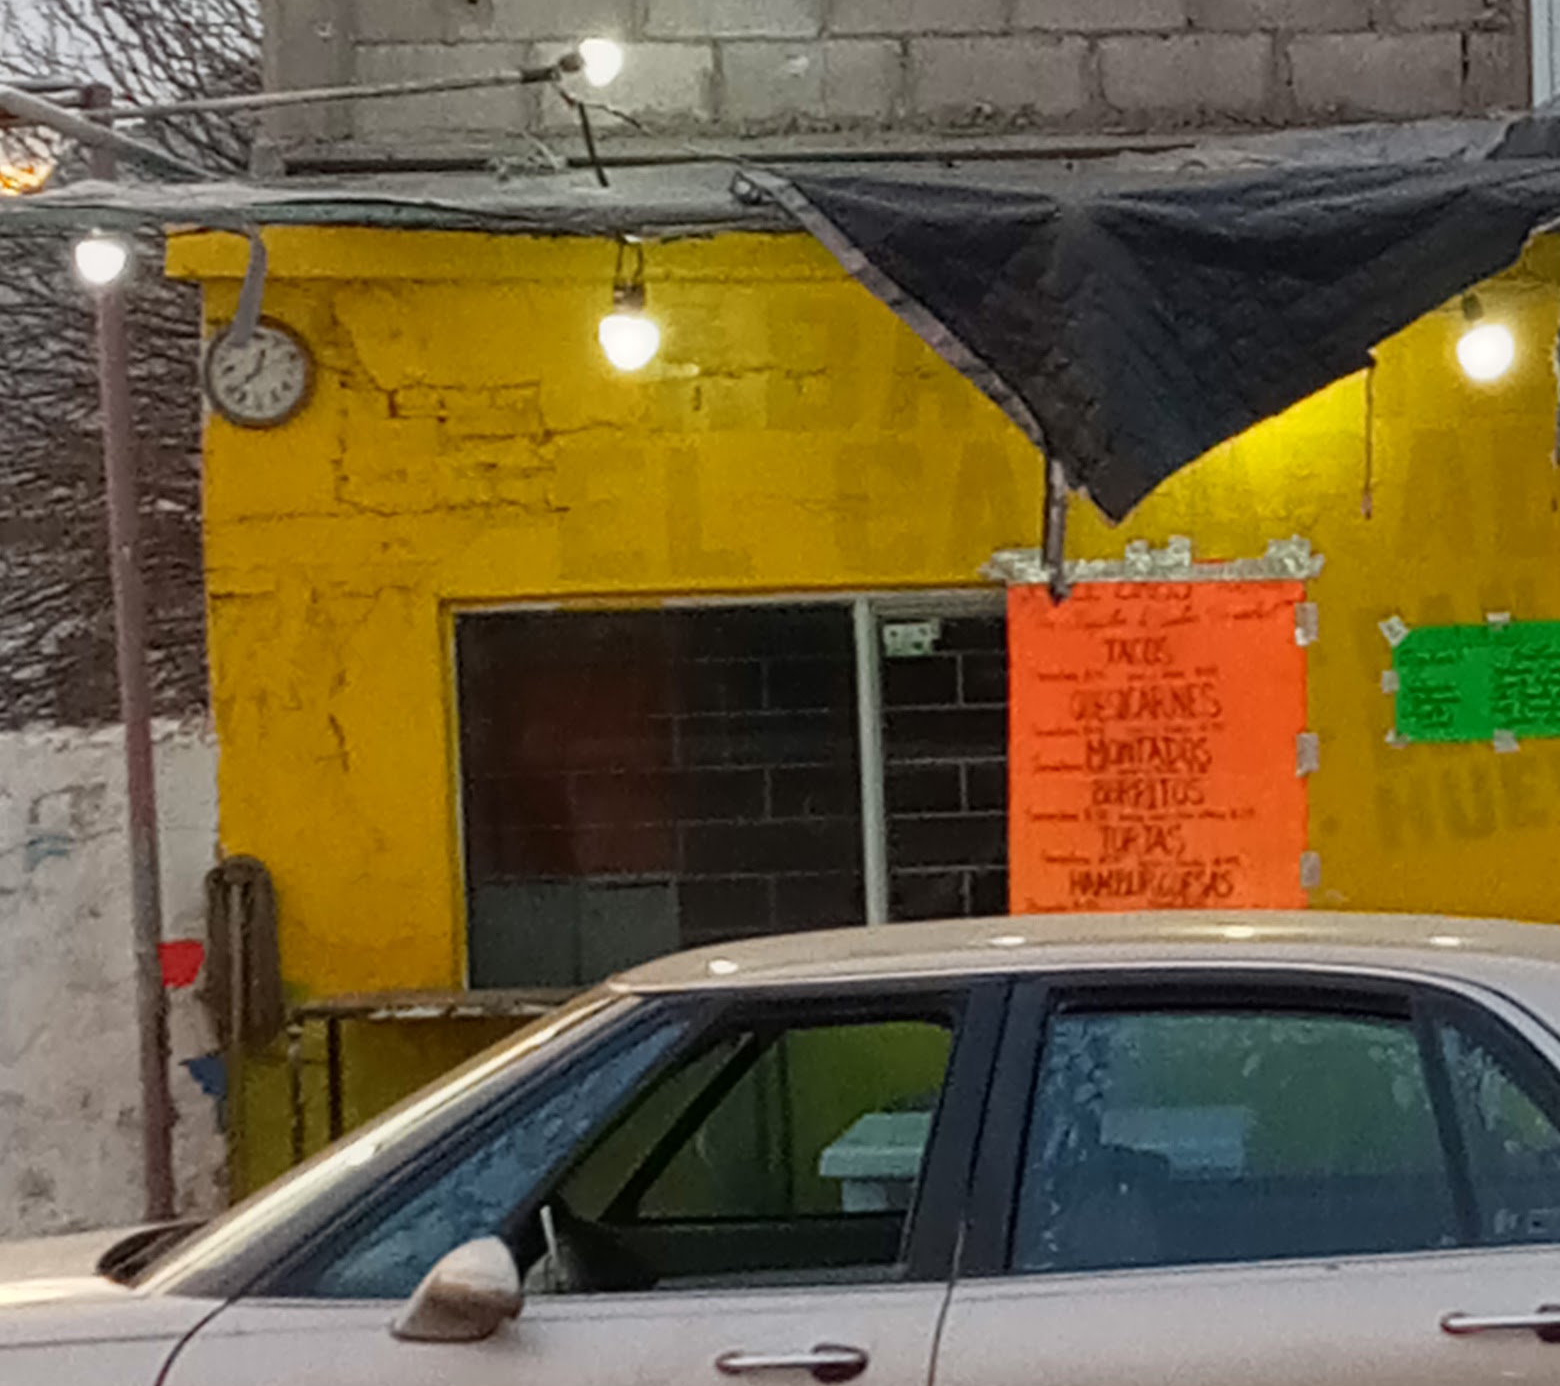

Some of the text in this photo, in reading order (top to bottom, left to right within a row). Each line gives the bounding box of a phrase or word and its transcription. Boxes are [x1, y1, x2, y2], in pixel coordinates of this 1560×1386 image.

[1104, 636, 1173, 665] TACOS
[1085, 736, 1213, 774] MONTADOS
[1091, 779, 1204, 809] BURRITOS
[1100, 824, 1186, 856] TORTAS
[1069, 868, 1236, 899] HAMBURGUESAS
